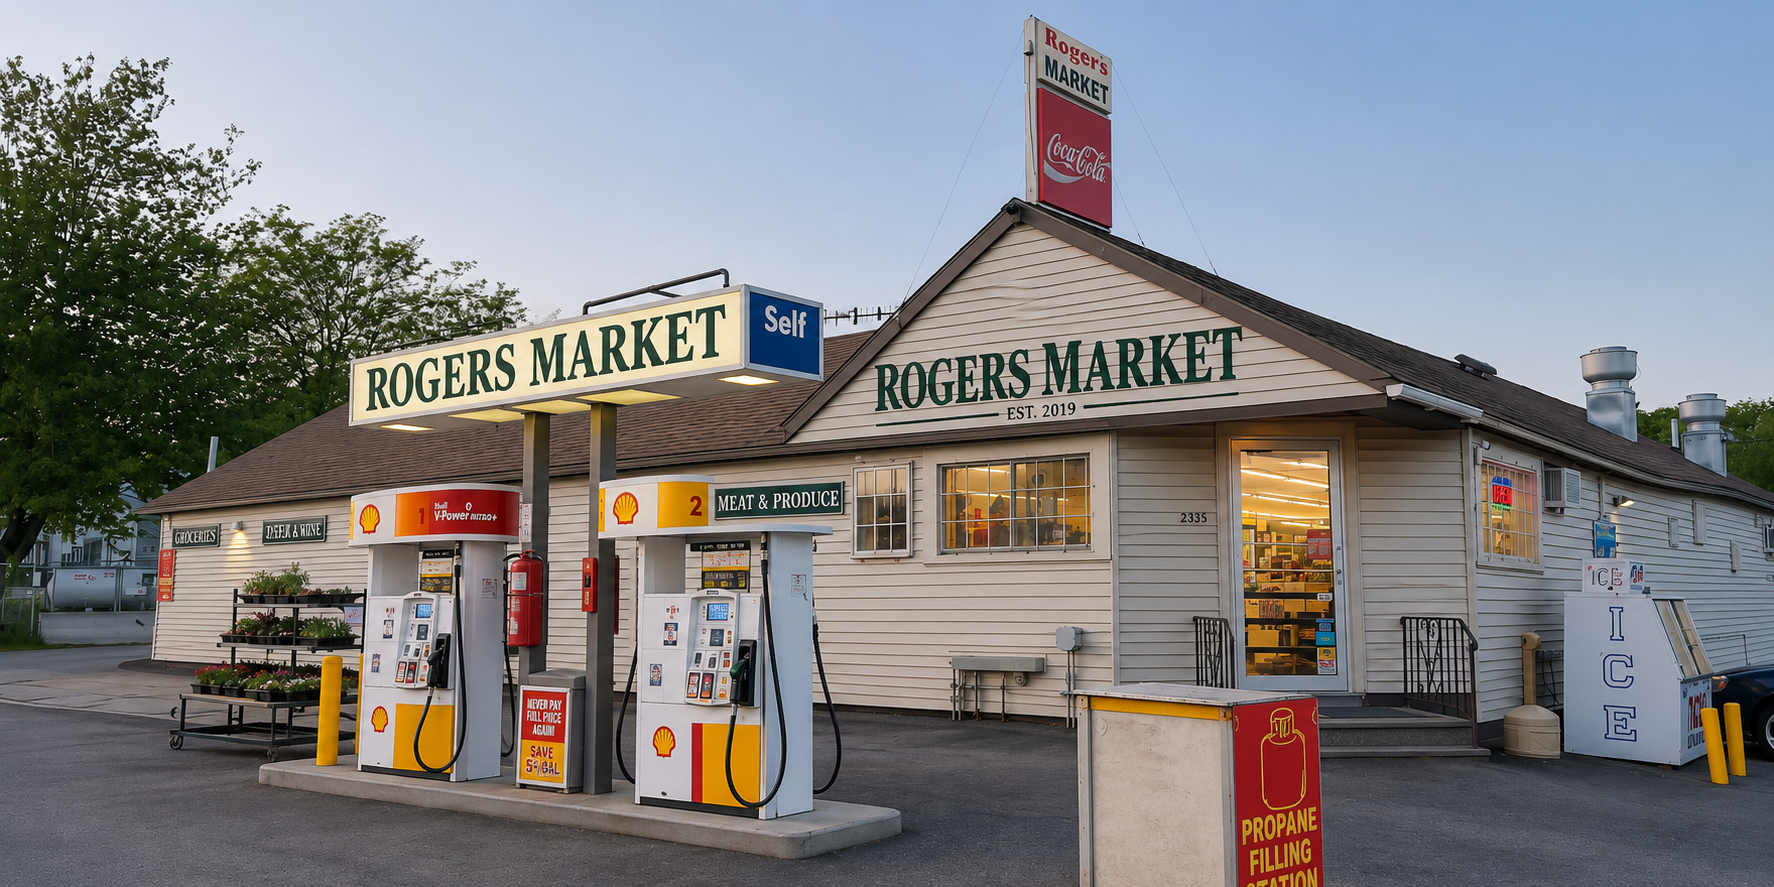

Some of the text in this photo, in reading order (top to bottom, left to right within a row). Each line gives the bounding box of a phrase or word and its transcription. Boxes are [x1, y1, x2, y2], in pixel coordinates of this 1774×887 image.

[1045, 26, 1108, 76] Rogers
[1045, 55, 1109, 104] MARKET
[1047, 133, 1107, 183] Coca-Cola
[764, 303, 808, 339] Self
[365, 304, 727, 412] ROGERS MARKET
[875, 326, 1243, 412] ROGERS MARKET
[1006, 402, 1077, 421] EST. 2019
[418, 507, 425, 525] 1
[434, 510, 469, 522] V-Power
[689, 496, 702, 516] 2
[717, 490, 839, 512] MEAT & PRODUCE
[1180, 512, 1207, 523] 2335
[1602, 606, 1637, 742] ICE
[549, 699, 562, 711] PAY
[530, 745, 554, 759] SAVE
[1242, 806, 1317, 845] PROPANE
[1249, 838, 1312, 876] FILLING
